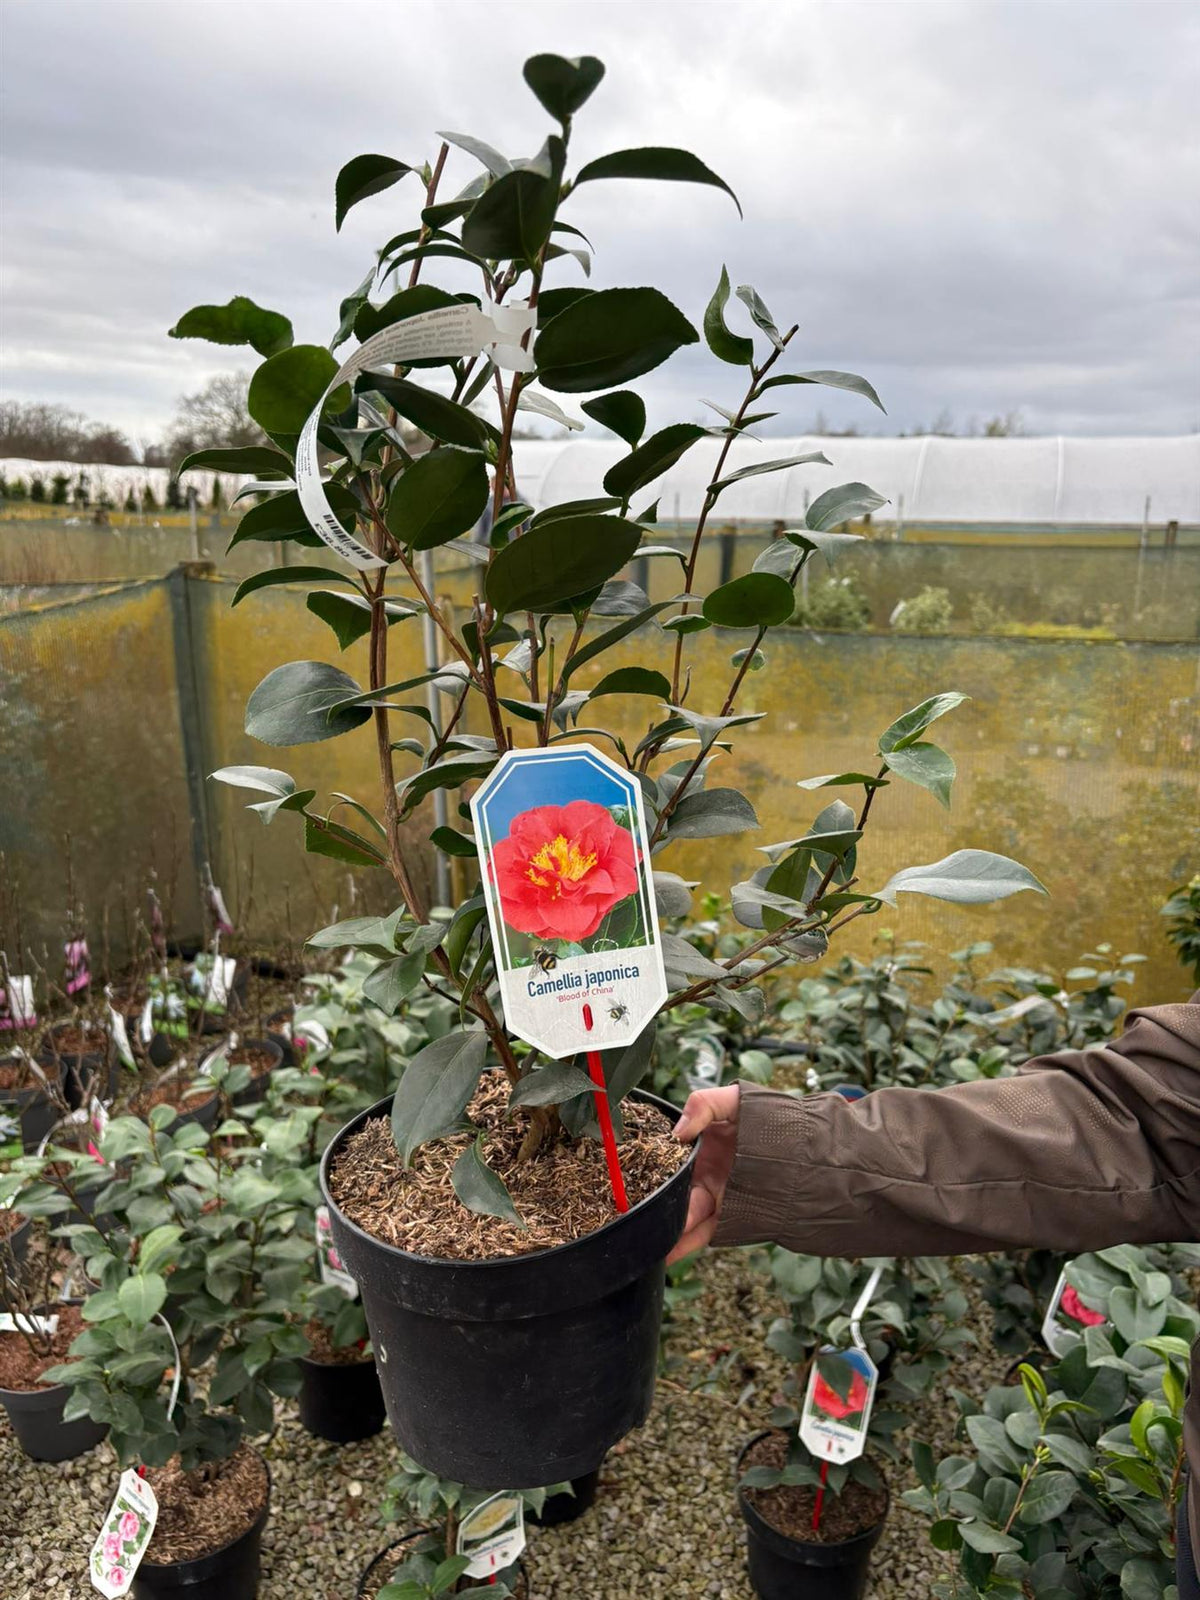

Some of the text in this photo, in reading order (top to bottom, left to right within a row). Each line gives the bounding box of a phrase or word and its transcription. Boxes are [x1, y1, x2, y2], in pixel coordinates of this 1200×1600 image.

[527, 964, 640, 997] Camellia japonica
[581, 989, 590, 998] of
